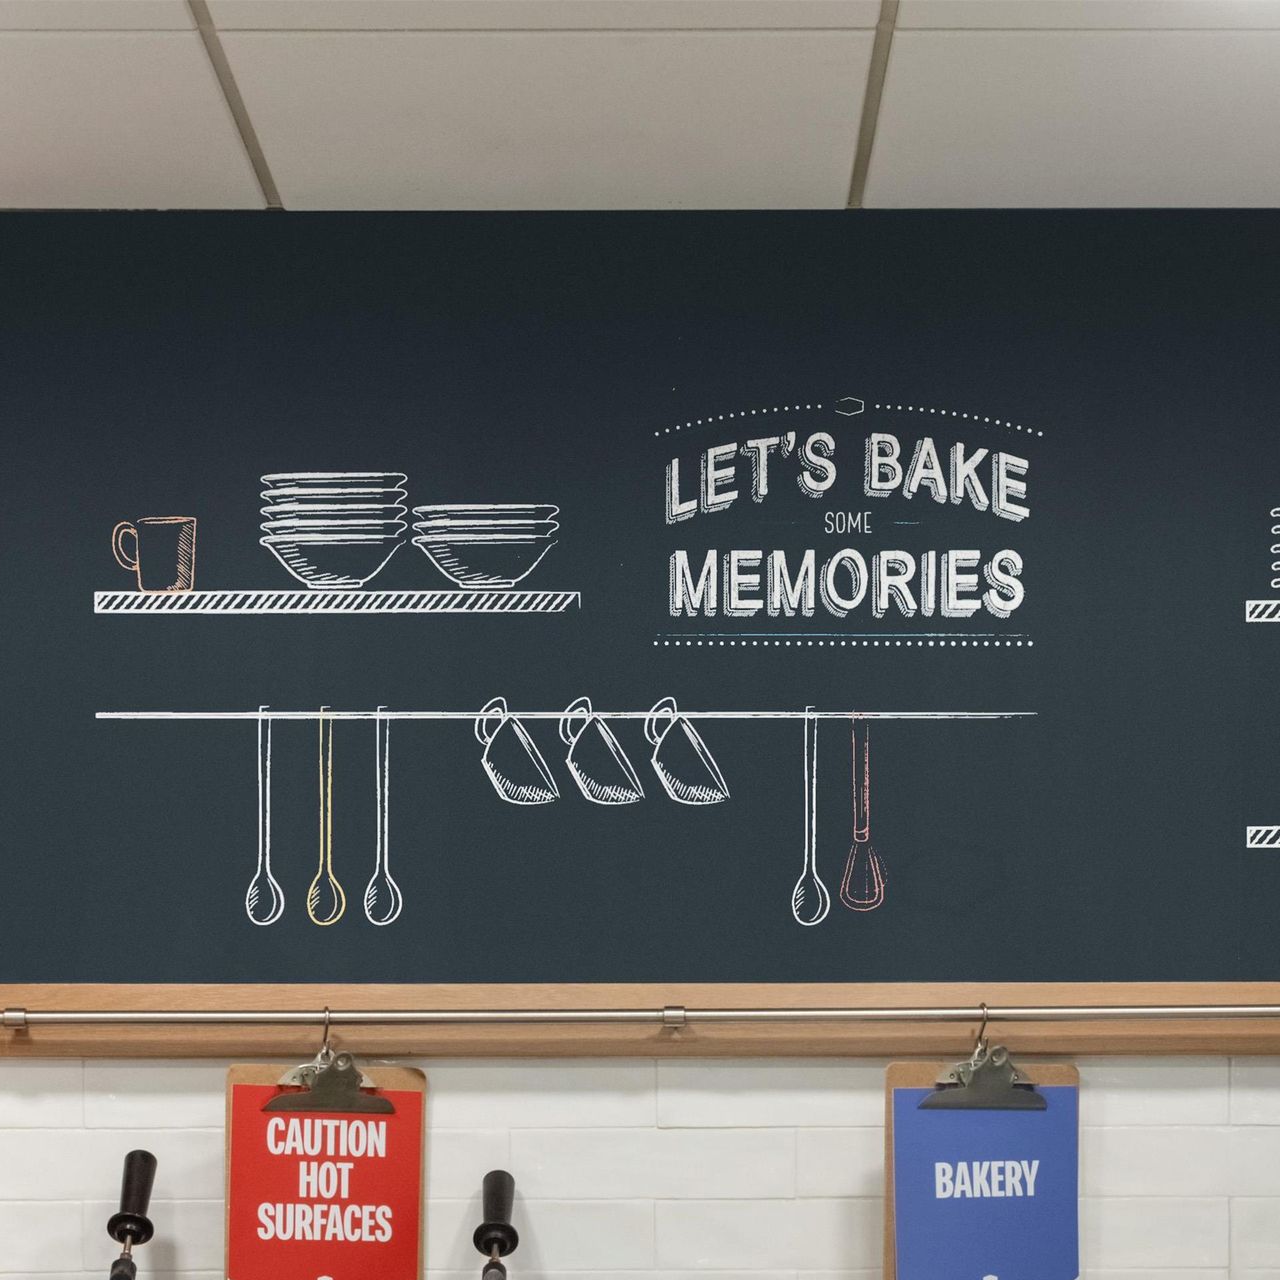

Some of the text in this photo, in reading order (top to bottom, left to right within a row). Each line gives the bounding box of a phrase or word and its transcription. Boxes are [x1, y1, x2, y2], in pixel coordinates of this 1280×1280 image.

[863, 432, 1030, 522] BAKE
[825, 512, 872, 533] SOME
[669, 548, 1025, 618] MEMORIES
[267, 1117, 386, 1157] CAUTION
[299, 1161, 354, 1199] HOT
[935, 1160, 1039, 1198] BAKERY
[257, 1202, 392, 1242] SURFACES
